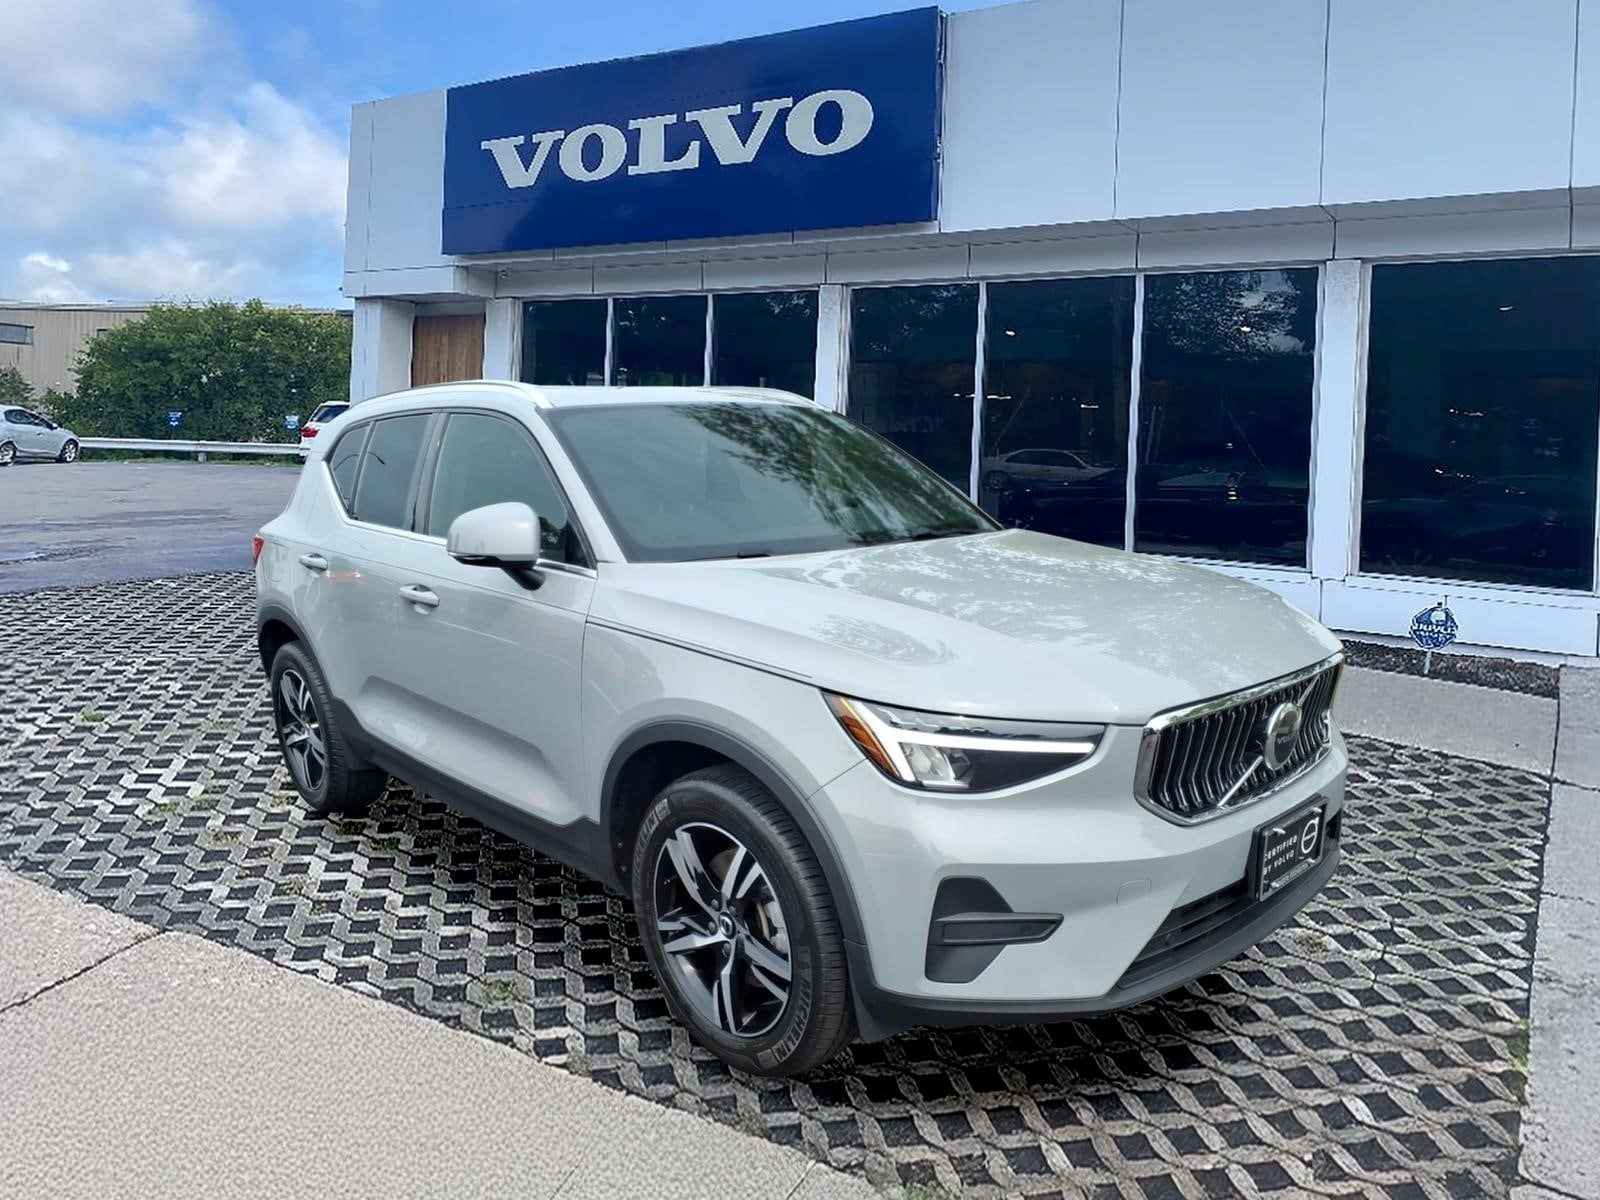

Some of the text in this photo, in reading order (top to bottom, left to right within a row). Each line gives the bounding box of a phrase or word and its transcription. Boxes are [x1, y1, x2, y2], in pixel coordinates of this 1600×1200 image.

[481, 88, 875, 189] VOLVO
[1274, 850, 1295, 868] VOLVO
[772, 976, 812, 1063] MICHELIN
